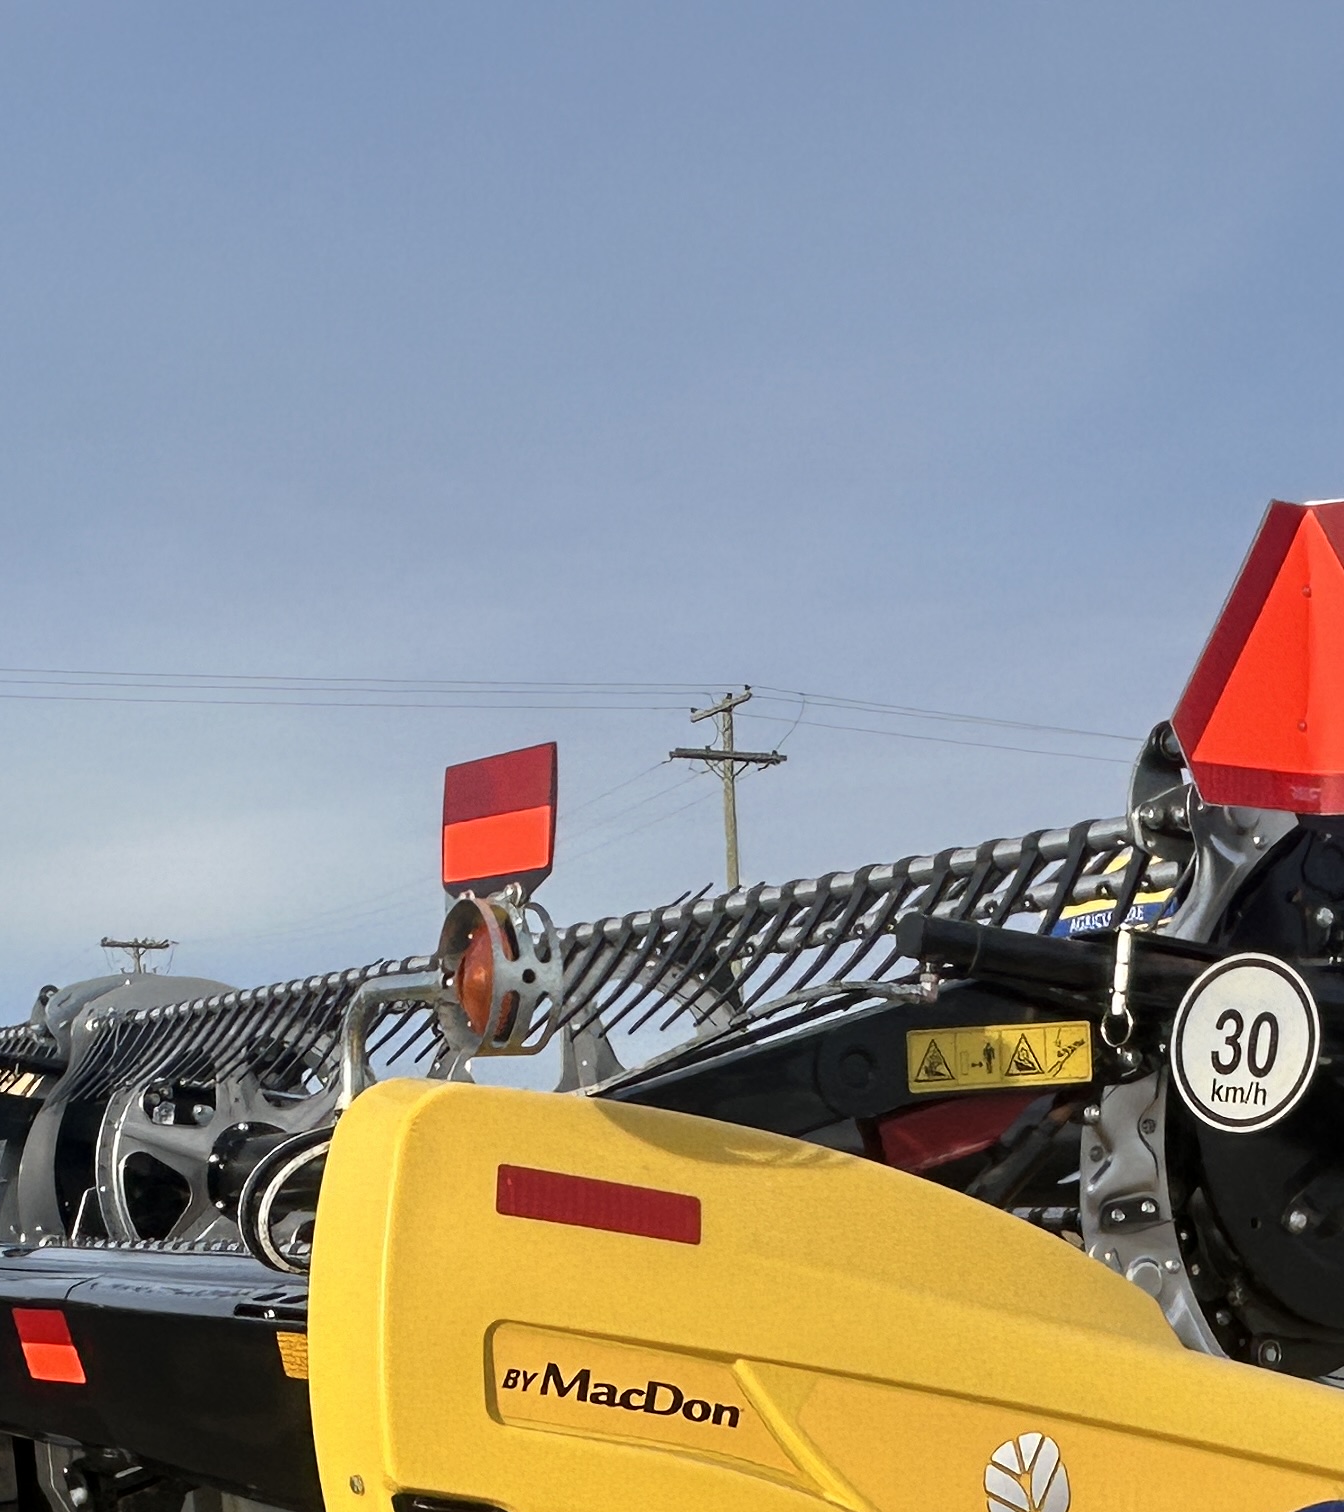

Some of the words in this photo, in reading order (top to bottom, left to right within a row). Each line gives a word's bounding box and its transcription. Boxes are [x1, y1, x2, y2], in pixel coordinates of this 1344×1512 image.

[1211, 1008, 1280, 1079] 30
[1211, 1078, 1267, 1106] km/h
[502, 1368, 538, 1392] BY
[540, 1362, 741, 1428] MacDon
